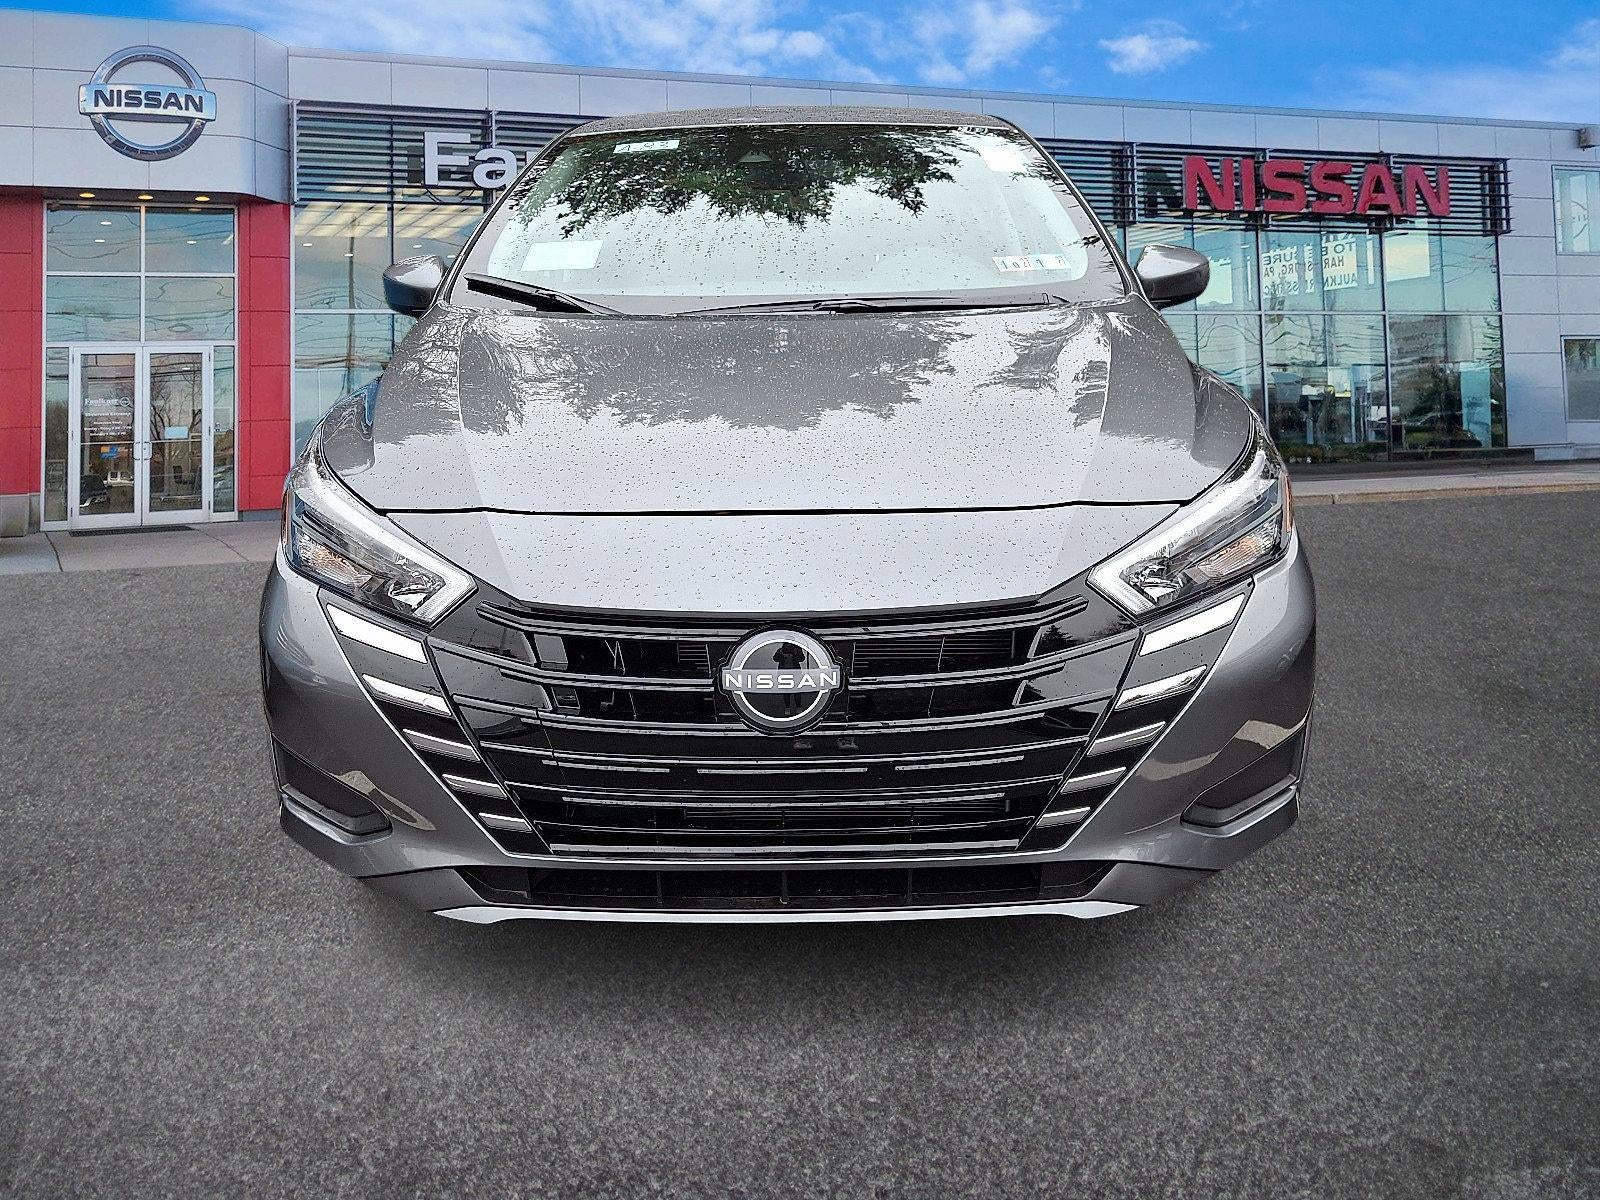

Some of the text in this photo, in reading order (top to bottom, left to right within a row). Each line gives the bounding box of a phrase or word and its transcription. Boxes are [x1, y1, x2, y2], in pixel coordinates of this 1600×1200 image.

[93, 89, 204, 113] NISSAN
[423, 131, 540, 189] Fa
[1183, 154, 1450, 217] NISSAN
[725, 671, 838, 690] NISSAN
